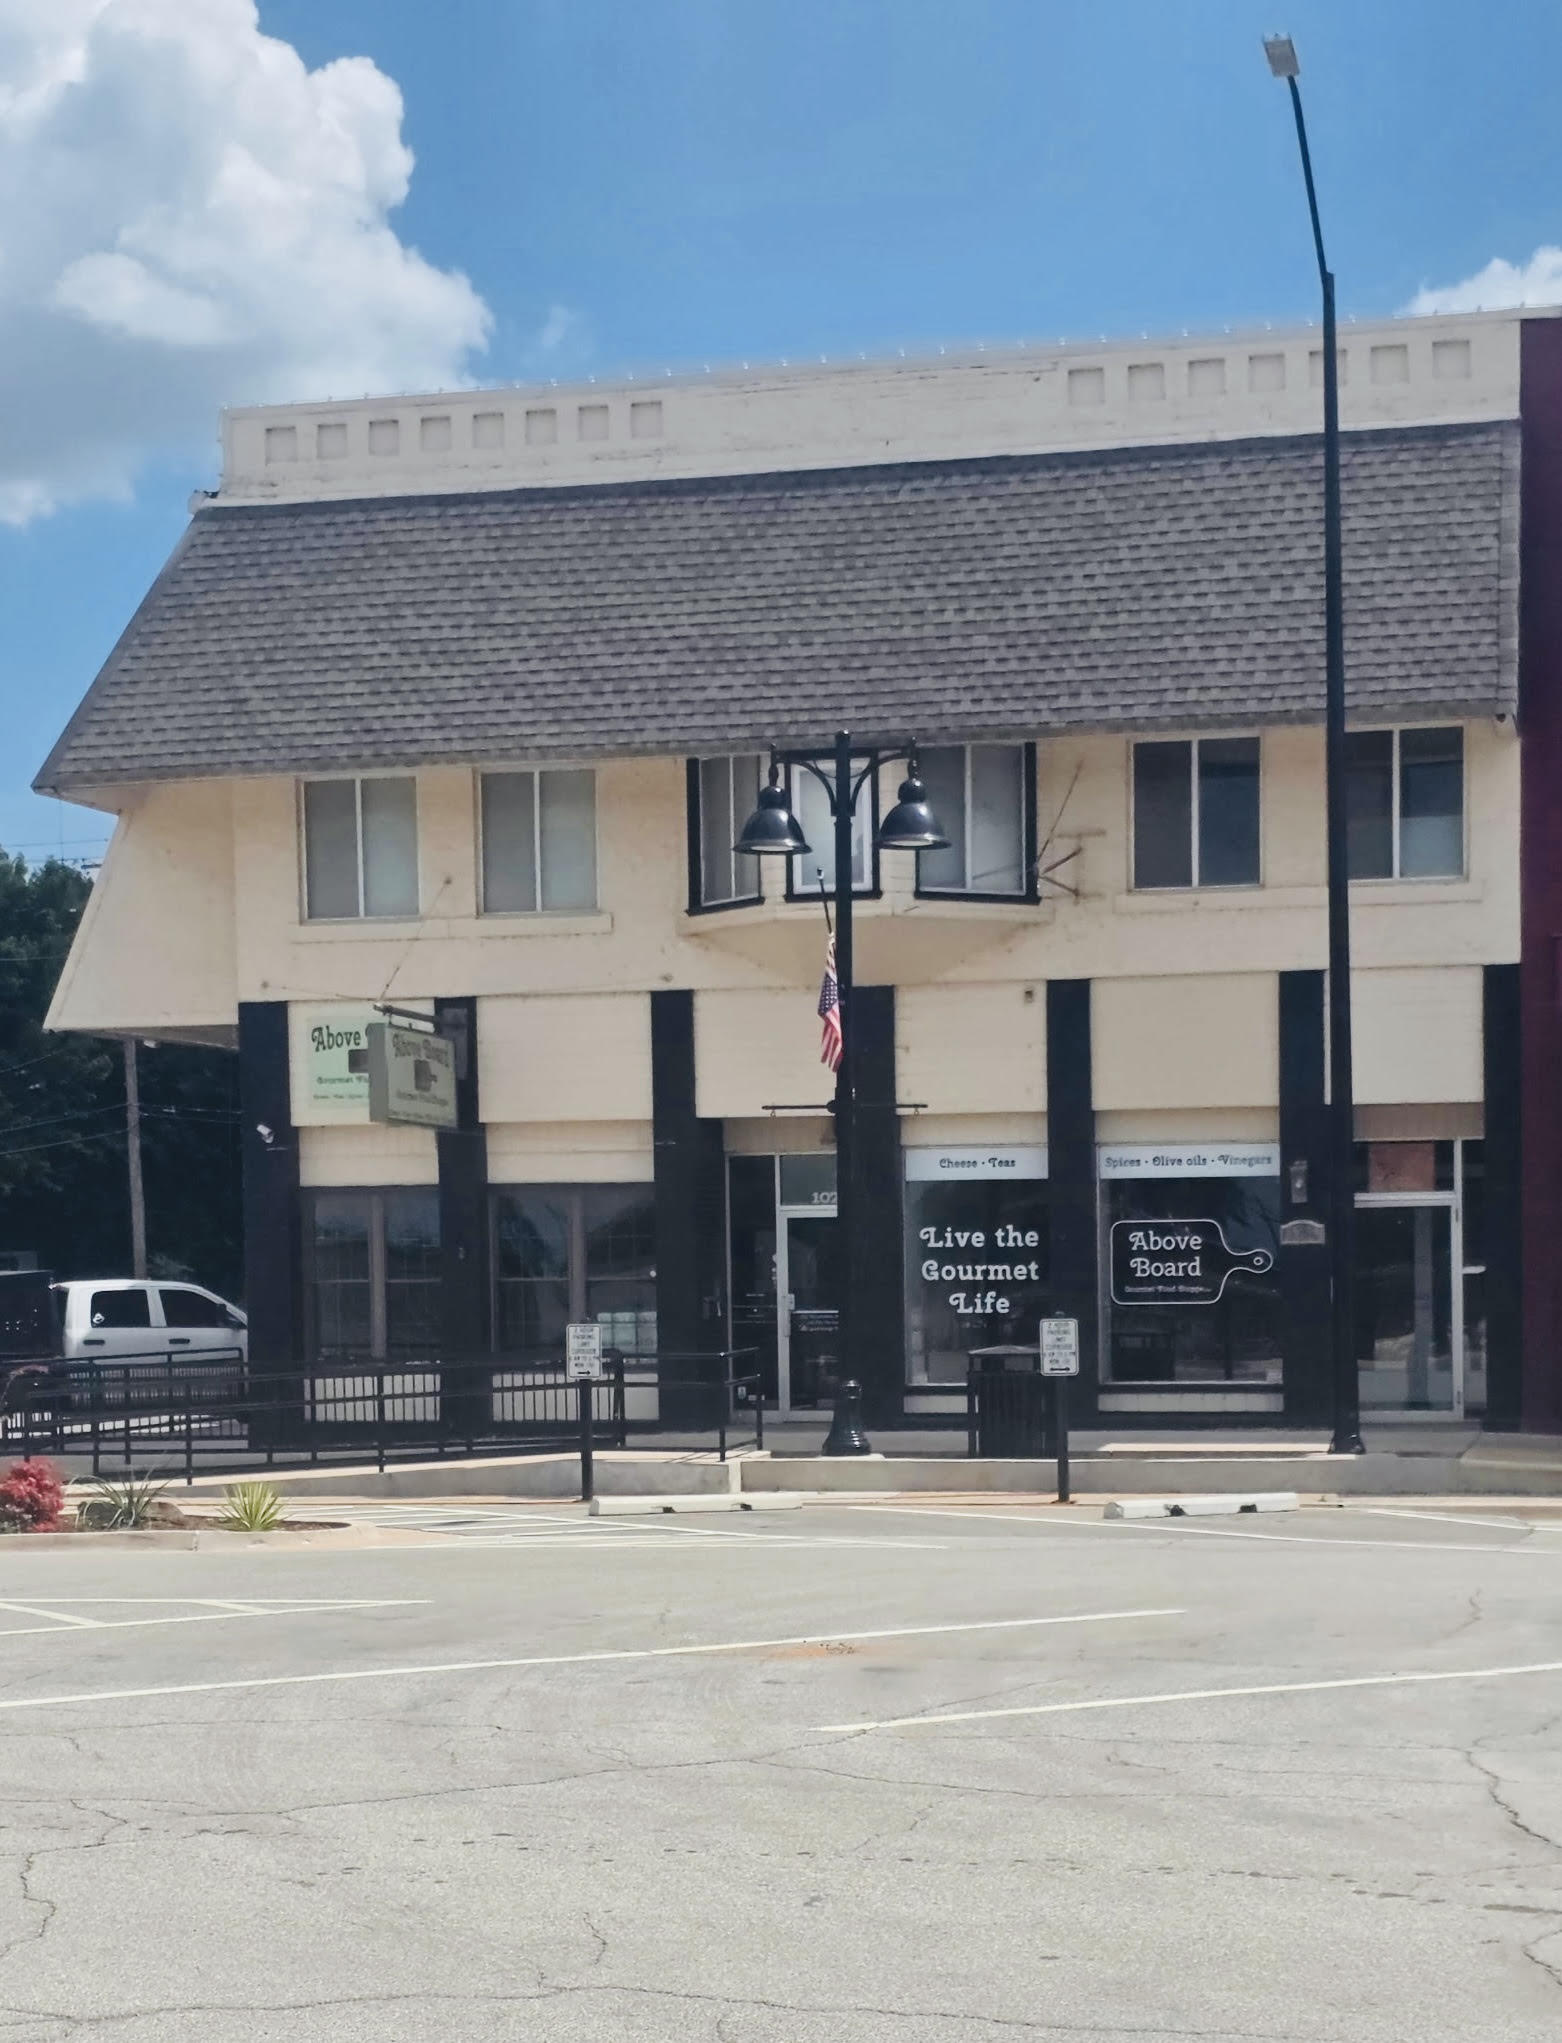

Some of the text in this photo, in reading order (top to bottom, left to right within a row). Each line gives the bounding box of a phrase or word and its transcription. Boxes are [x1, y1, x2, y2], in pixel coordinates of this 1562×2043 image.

[311, 1025, 362, 1052] Above
[938, 1157, 1016, 1169] Cheese Teas
[1103, 1156, 1142, 1170] Spices
[1152, 1155, 1183, 1167] Olive
[1186, 1154, 1208, 1167] oils
[918, 1224, 1040, 1248] Live the
[1128, 1230, 1203, 1252] Above
[920, 1259, 1040, 1281] Gourmet
[1129, 1257, 1202, 1278] Board
[947, 1290, 1011, 1315] Life
